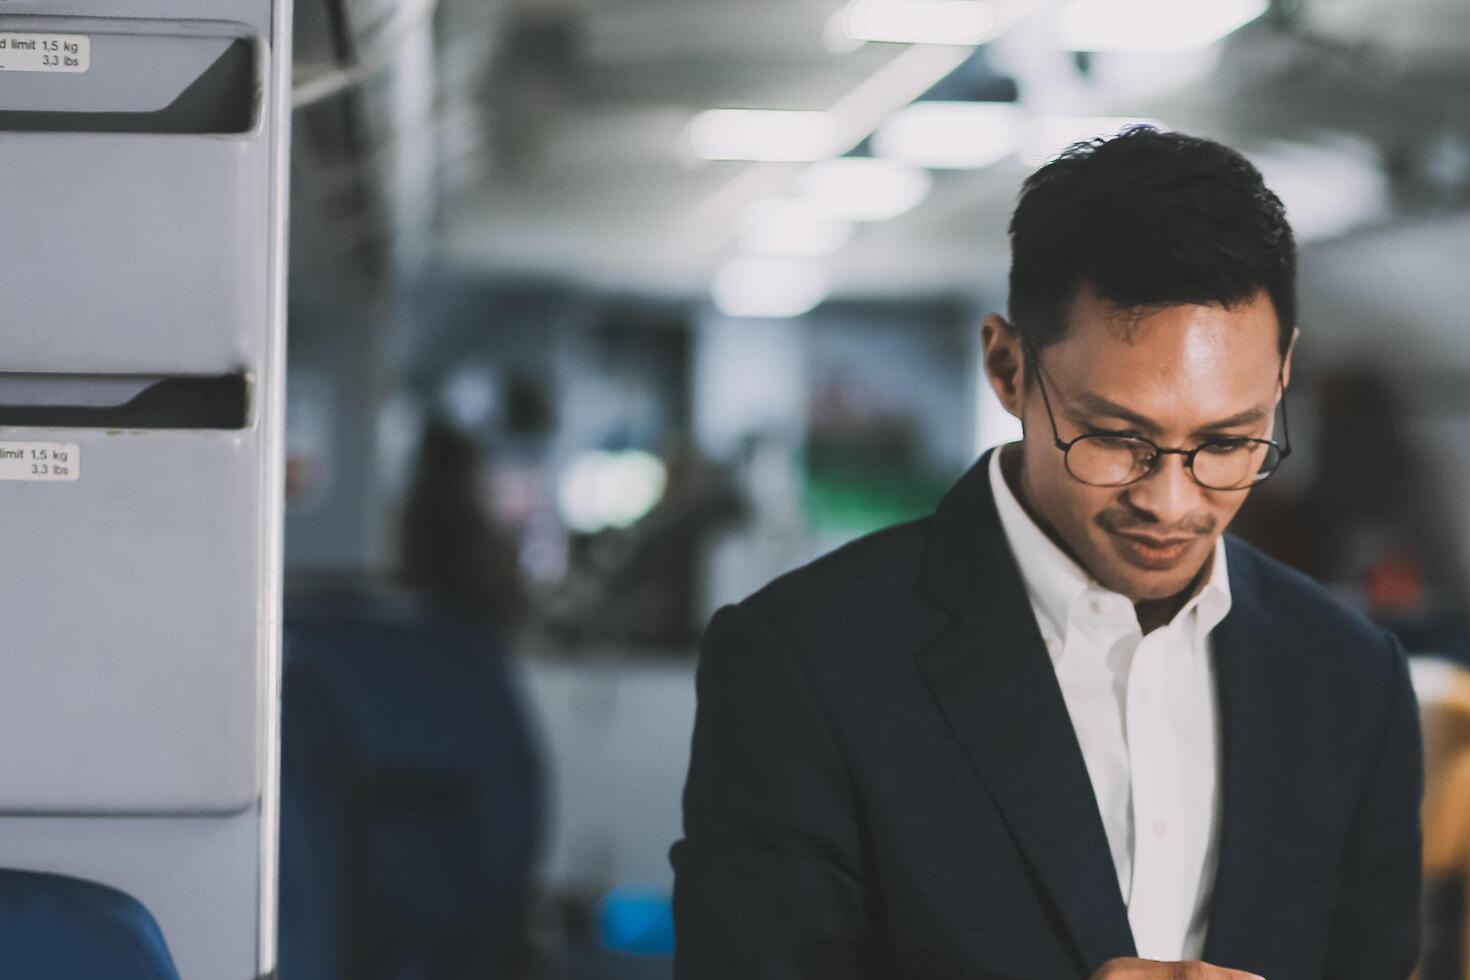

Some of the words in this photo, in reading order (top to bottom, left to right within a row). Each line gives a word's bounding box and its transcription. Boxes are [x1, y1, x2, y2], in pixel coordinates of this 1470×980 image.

[11, 40, 36, 50] limit
[64, 41, 79, 53] kg
[64, 56, 79, 66] lbs
[0, 448, 24, 459] limit
[53, 449, 68, 462] kg
[53, 465, 68, 475] lbs
